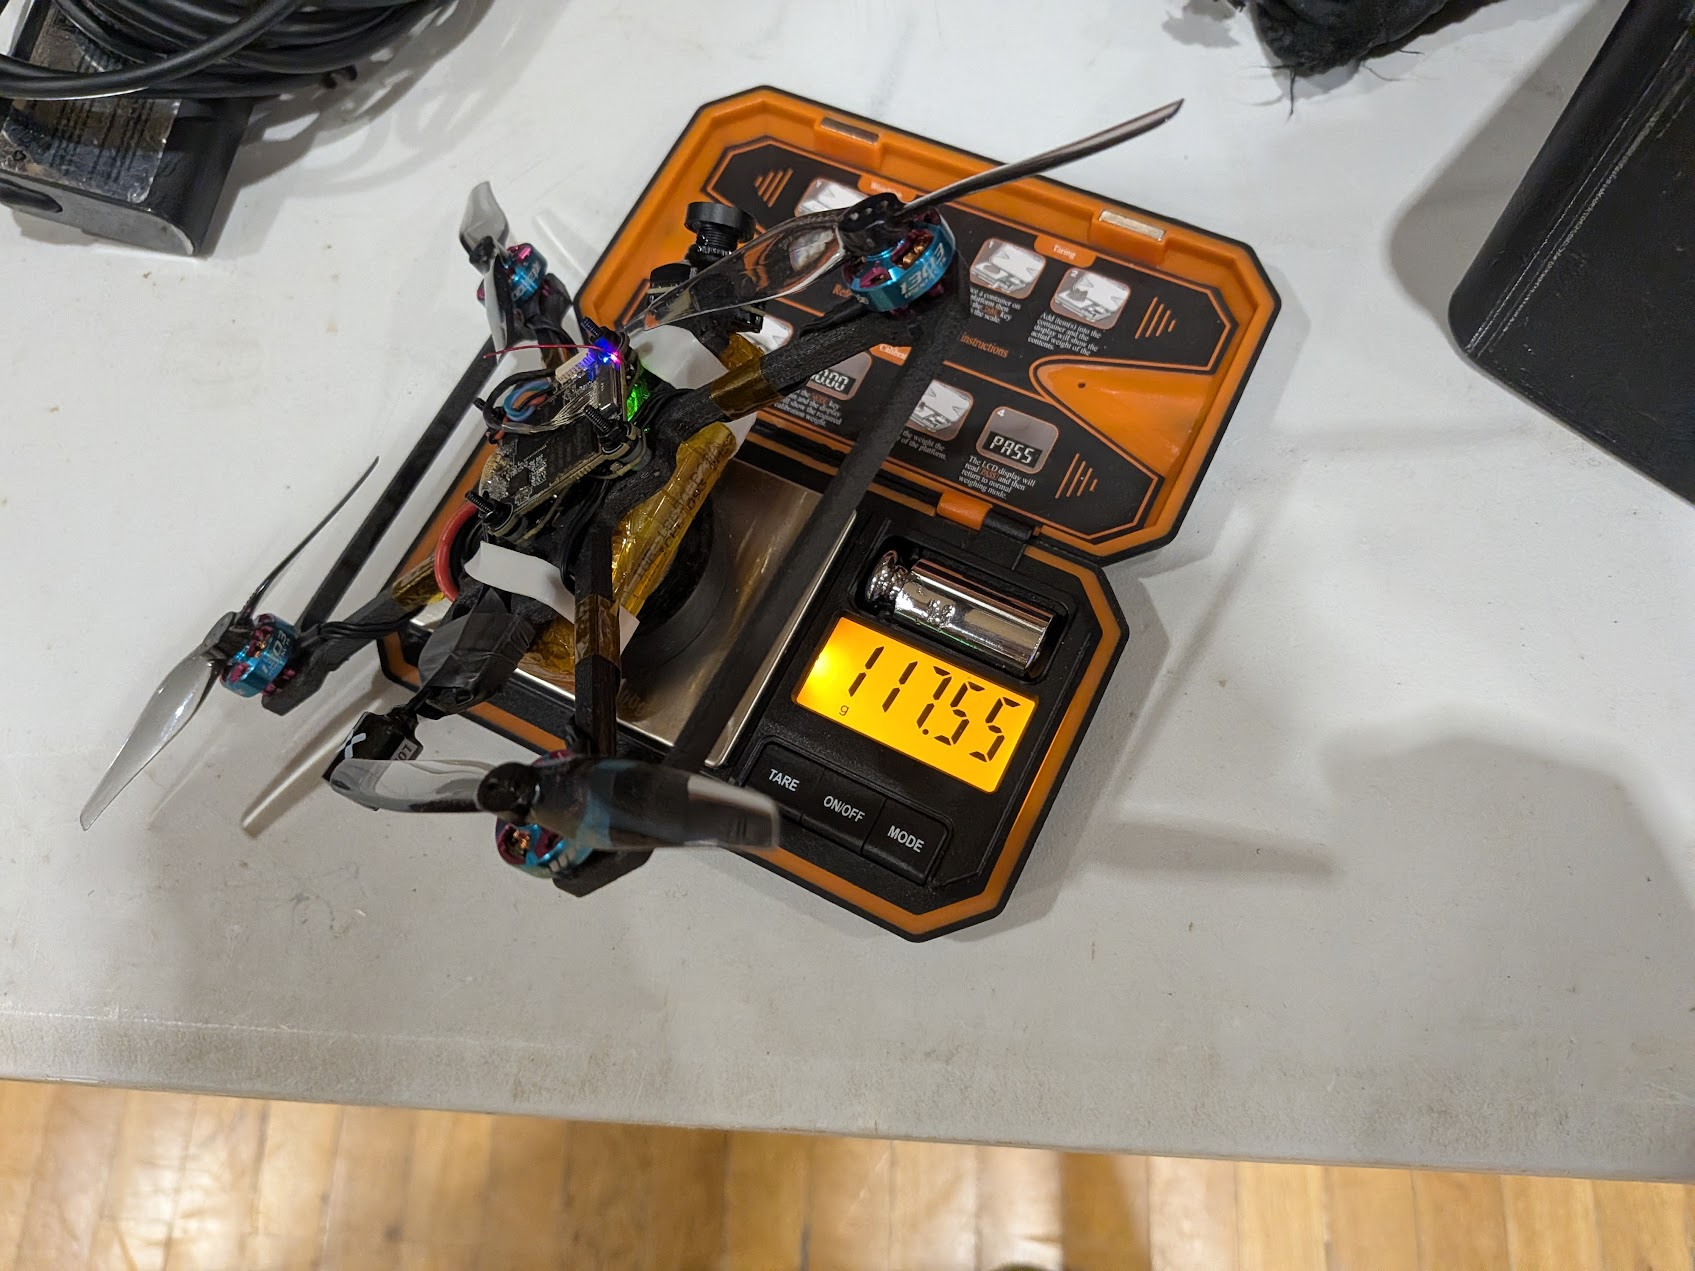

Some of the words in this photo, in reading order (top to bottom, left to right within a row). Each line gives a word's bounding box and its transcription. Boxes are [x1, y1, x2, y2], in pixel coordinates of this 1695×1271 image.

[1053, 244, 1076, 260] Taring
[984, 293, 1012, 306] container
[1034, 324, 1057, 338] display
[1057, 332, 1071, 341] will
[1071, 337, 1088, 348] show
[1088, 343, 1099, 352] the
[1037, 319, 1066, 333] container
[1066, 328, 1079, 338] and
[1079, 332, 1090, 341] the
[1040, 311, 1055, 322] Add
[1055, 316, 1077, 330] item(s)
[1091, 330, 1102, 339] the
[961, 332, 1009, 358] instructions
[1031, 330, 1050, 342] actual
[1051, 337, 1072, 349] weight
[1080, 347, 1091, 356] the
[909, 440, 920, 449] the
[913, 434, 935, 447] weight
[934, 442, 946, 452] the
[989, 435, 1035, 464] PASS
[961, 469, 981, 481] return
[988, 480, 1013, 494] normal
[964, 462, 980, 473] read
[998, 476, 1011, 485] and
[1011, 480, 1026, 491] then
[968, 455, 981, 466] The
[981, 460, 999, 472] LCD
[998, 467, 1022, 482] display
[1022, 477, 1036, 488] will
[958, 475, 987, 493] weighing
[987, 487, 1007, 500] mode.
[839, 705, 849, 716] g
[848, 646, 1021, 763] 117.55
[768, 768, 800, 792] TARE
[823, 795, 866, 823] ON/OFF
[887, 825, 925, 853] MODE
